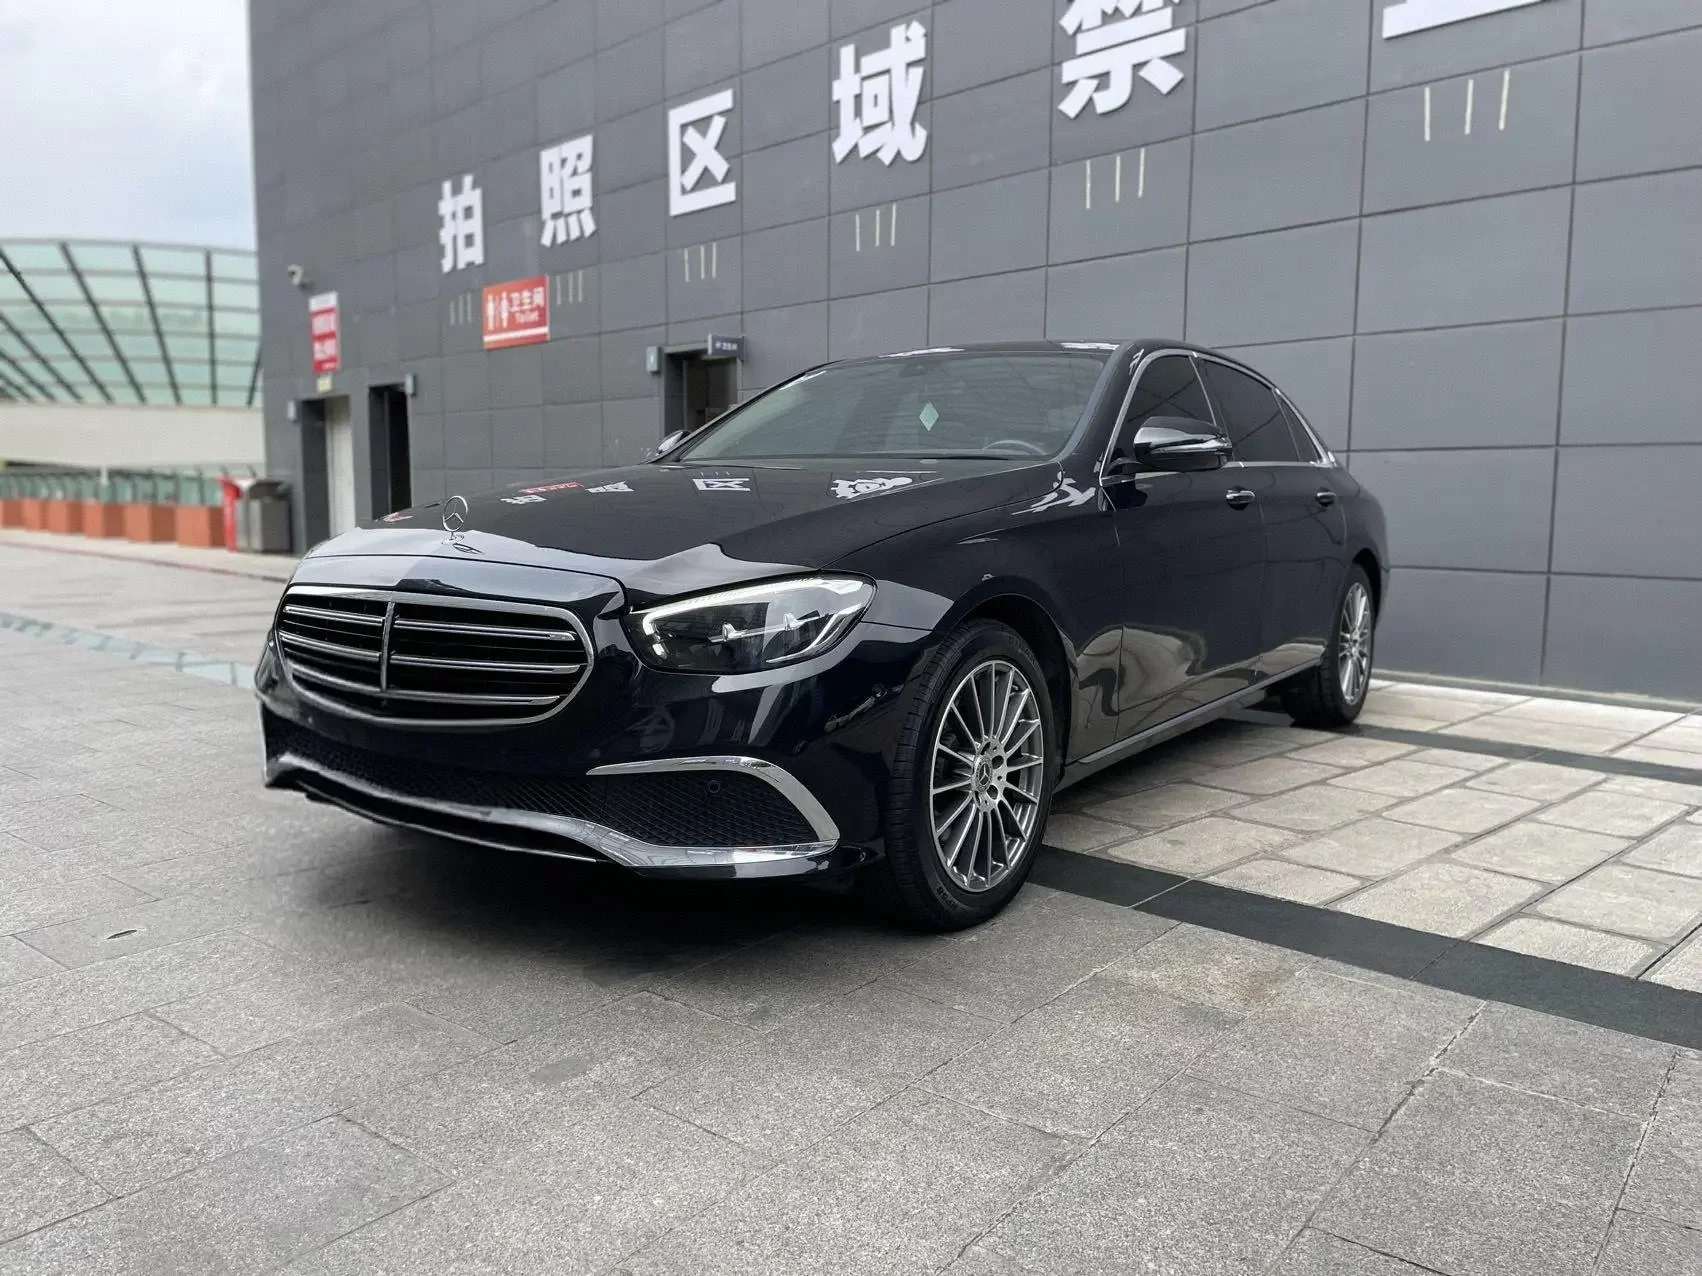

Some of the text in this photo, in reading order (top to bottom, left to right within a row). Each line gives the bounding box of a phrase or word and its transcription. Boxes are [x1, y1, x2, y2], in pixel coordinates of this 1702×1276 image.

[438, 0, 1546, 273] 拍照区域禁
